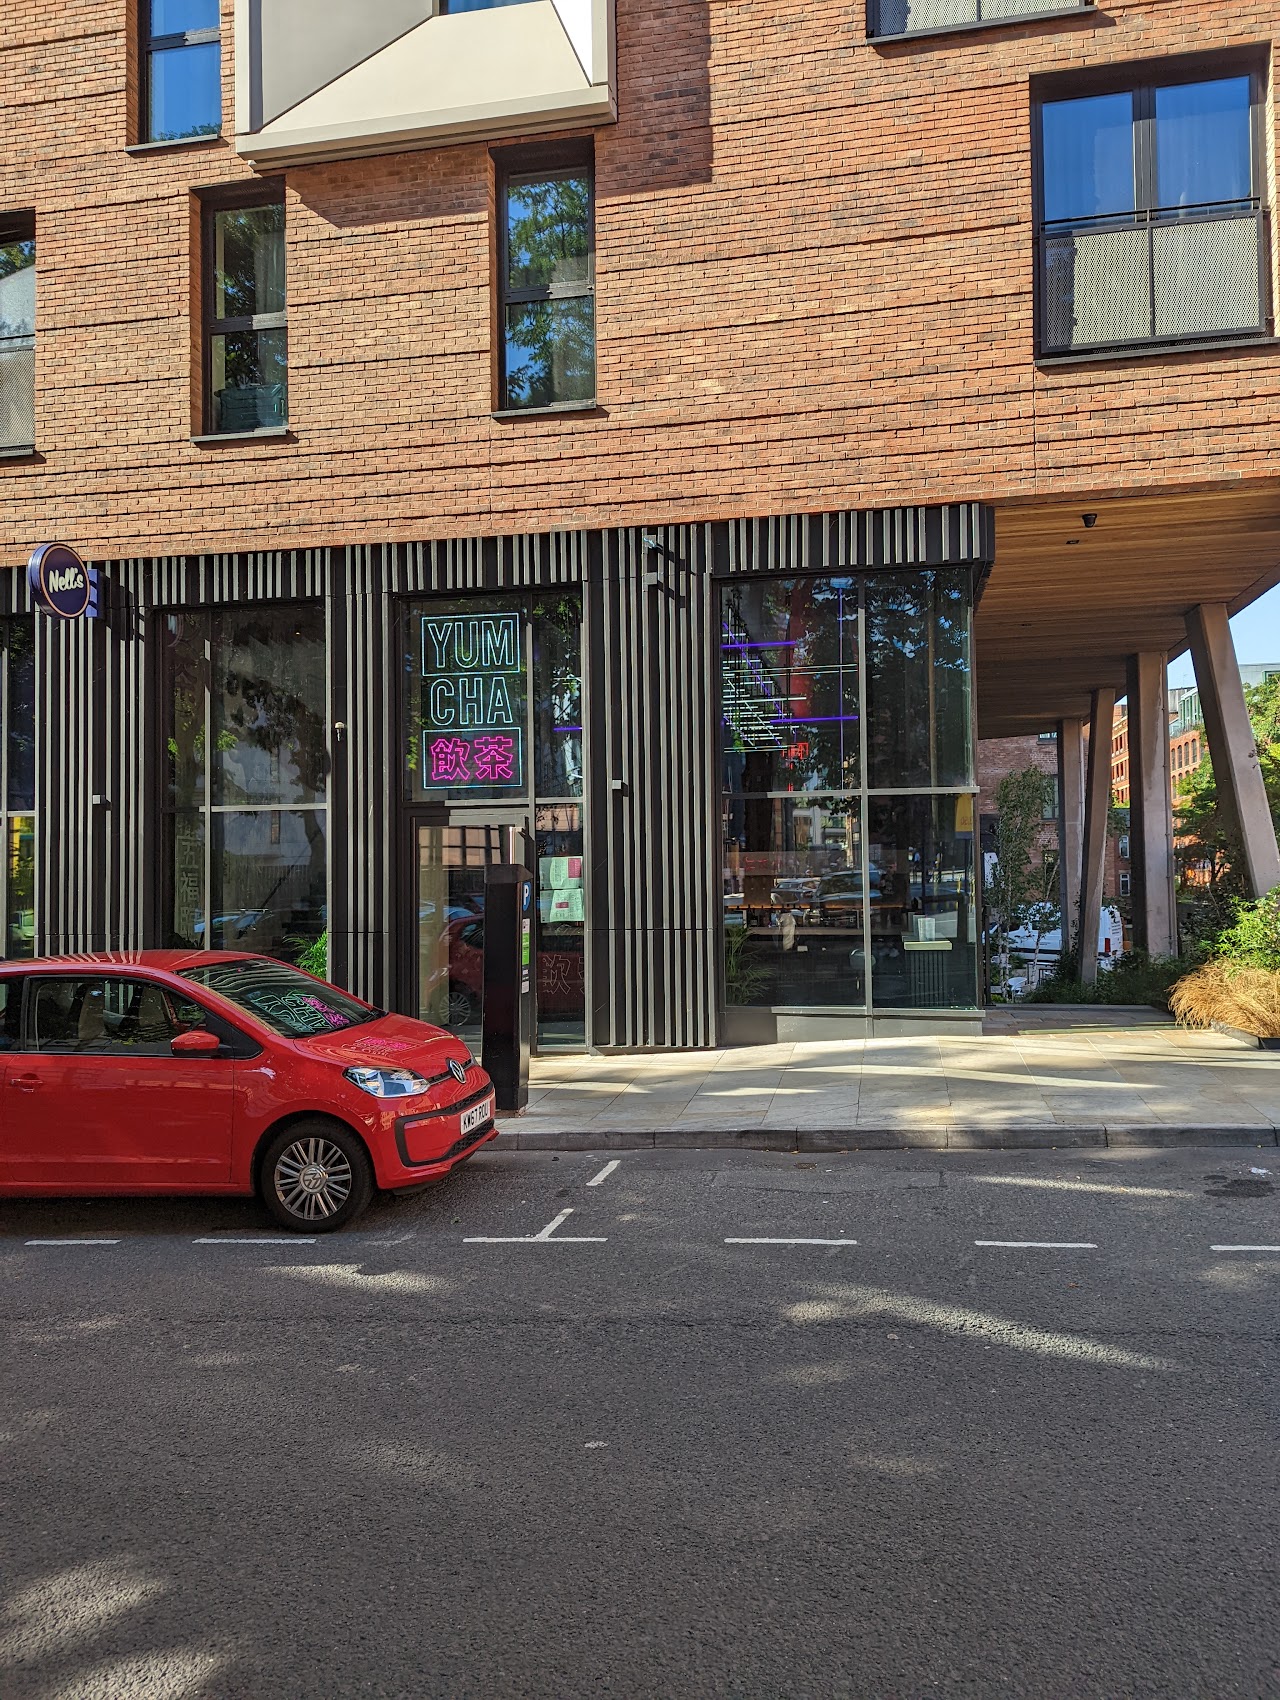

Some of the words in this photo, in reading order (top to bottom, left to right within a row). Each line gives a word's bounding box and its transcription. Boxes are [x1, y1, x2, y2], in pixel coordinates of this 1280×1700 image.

[49, 567, 84, 593] Nell's
[428, 620, 514, 668] YUM
[430, 677, 513, 726] CHA
[430, 736, 514, 781] 飲茶
